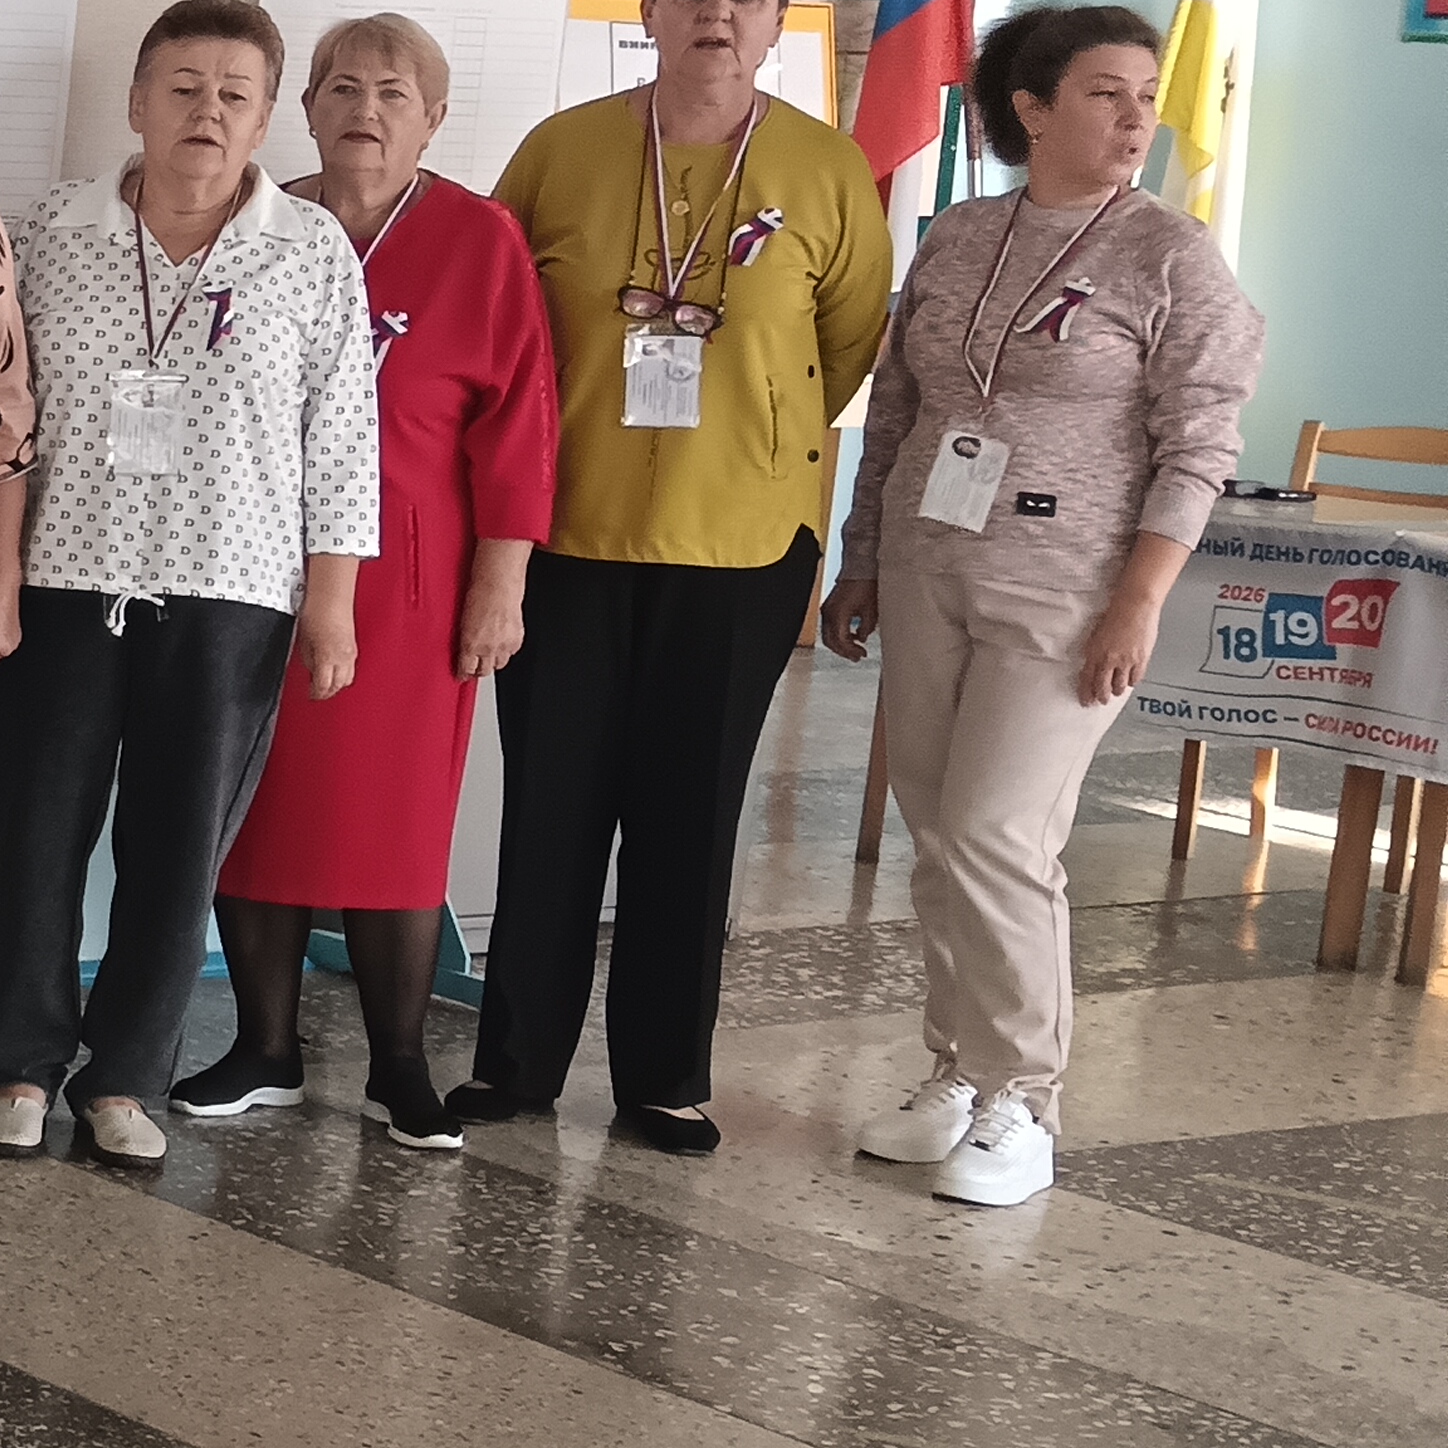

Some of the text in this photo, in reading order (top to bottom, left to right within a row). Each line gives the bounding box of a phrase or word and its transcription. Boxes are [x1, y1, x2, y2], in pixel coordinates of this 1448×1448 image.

[1196, 536, 1246, 558] НЫЙ
[1249, 543, 1305, 564] ДЕНЬ
[1217, 583, 1266, 604] 2026
[1216, 594, 1384, 663] 18 19 20
[1275, 663, 1374, 689] СЕНТЯБРЯ
[1136, 695, 1192, 720] ТВОЙ
[1199, 705, 1278, 725] ГОЛОС
[1340, 718, 1440, 755] РОССИИ!
